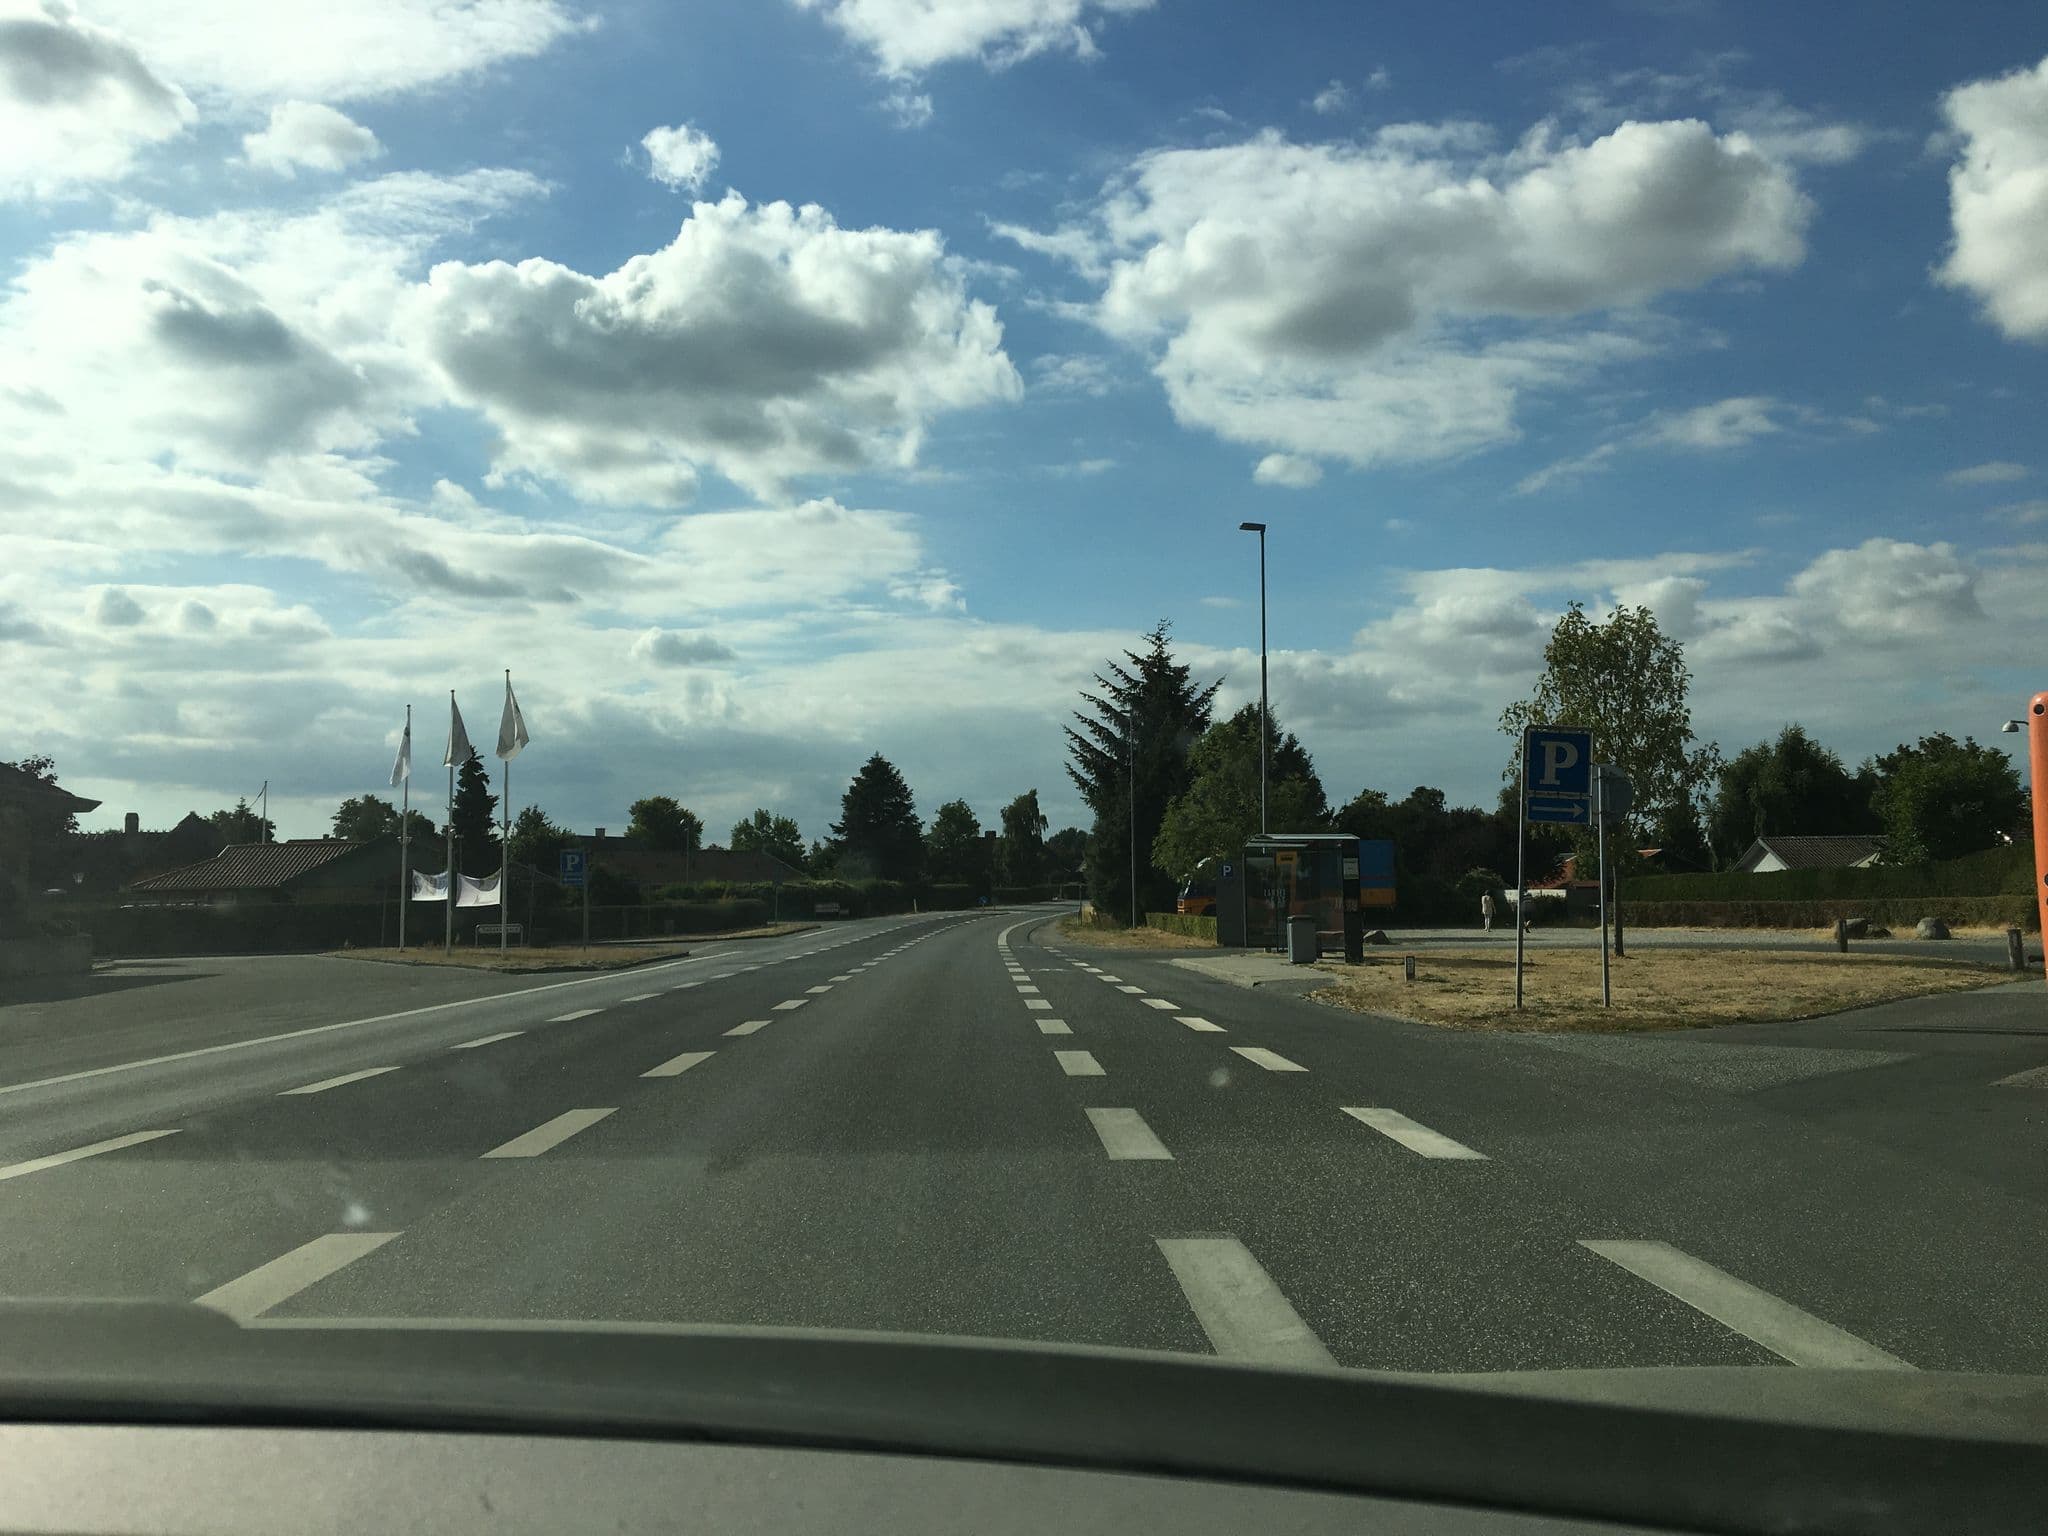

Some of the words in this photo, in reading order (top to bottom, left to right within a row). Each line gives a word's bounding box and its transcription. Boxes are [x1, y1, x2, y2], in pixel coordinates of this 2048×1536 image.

[1539, 741, 1579, 785] P
[567, 854, 580, 871] P
[1223, 865, 1232, 876] P
